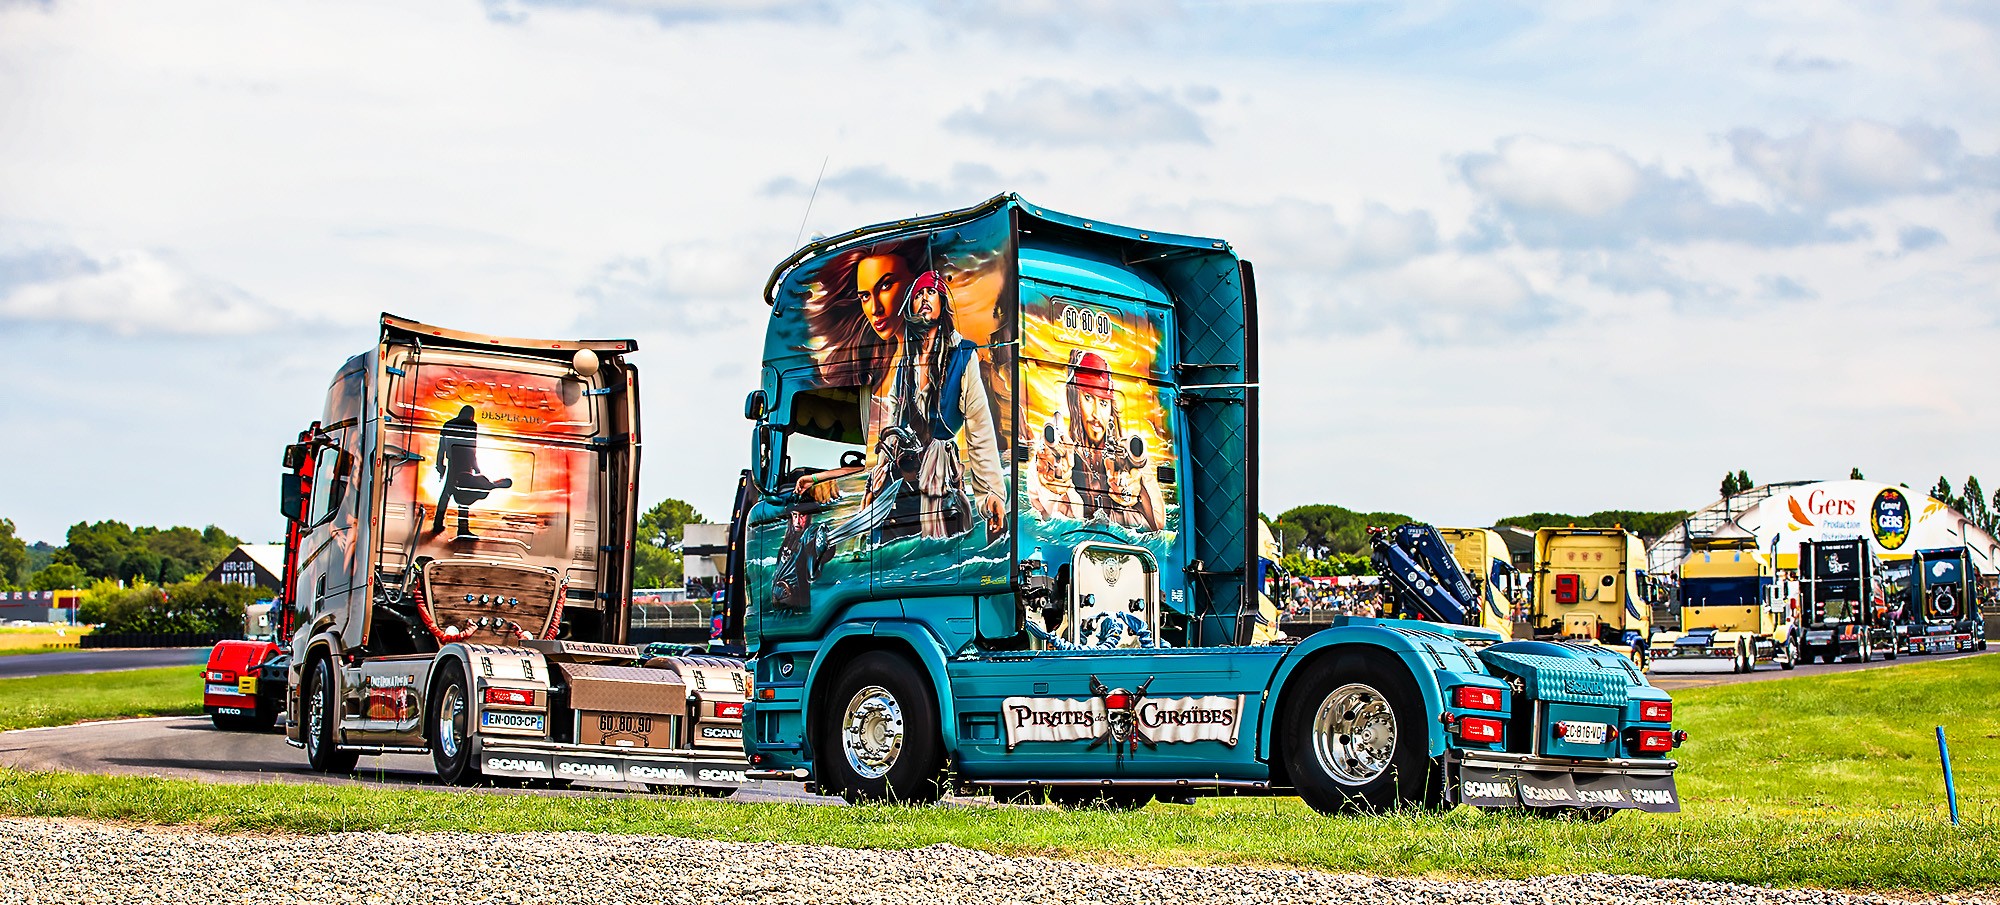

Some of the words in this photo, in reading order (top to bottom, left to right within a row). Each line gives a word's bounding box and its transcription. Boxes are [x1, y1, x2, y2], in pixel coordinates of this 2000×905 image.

[1066, 309, 1078, 329] 60
[1081, 312, 1093, 332] 80
[1097, 315, 1109, 335] 90
[434, 378, 556, 411] SCANIA
[481, 410, 545, 425] DESPERADO
[1808, 489, 1856, 515] Gers
[1823, 520, 1861, 529] Production
[218, 707, 241, 715] IVECO
[1009, 704, 1094, 728] PIRATES
[1095, 712, 1107, 722] des
[1140, 702, 1233, 728] CARAÏBES
[489, 713, 537, 727] EN-003-CP
[600, 714, 614, 731] 60
[619, 716, 633, 732] 80
[638, 716, 651, 733] 90
[487, 758, 547, 773] SCANIA
[558, 762, 618, 776] SCANIA
[629, 766, 688, 780] SCANIA
[1464, 780, 1512, 798] SCANIA
[1522, 784, 1572, 801] SCANIA
[1577, 788, 1626, 802] SCANIA
[1631, 788, 1674, 804] SCANIA
